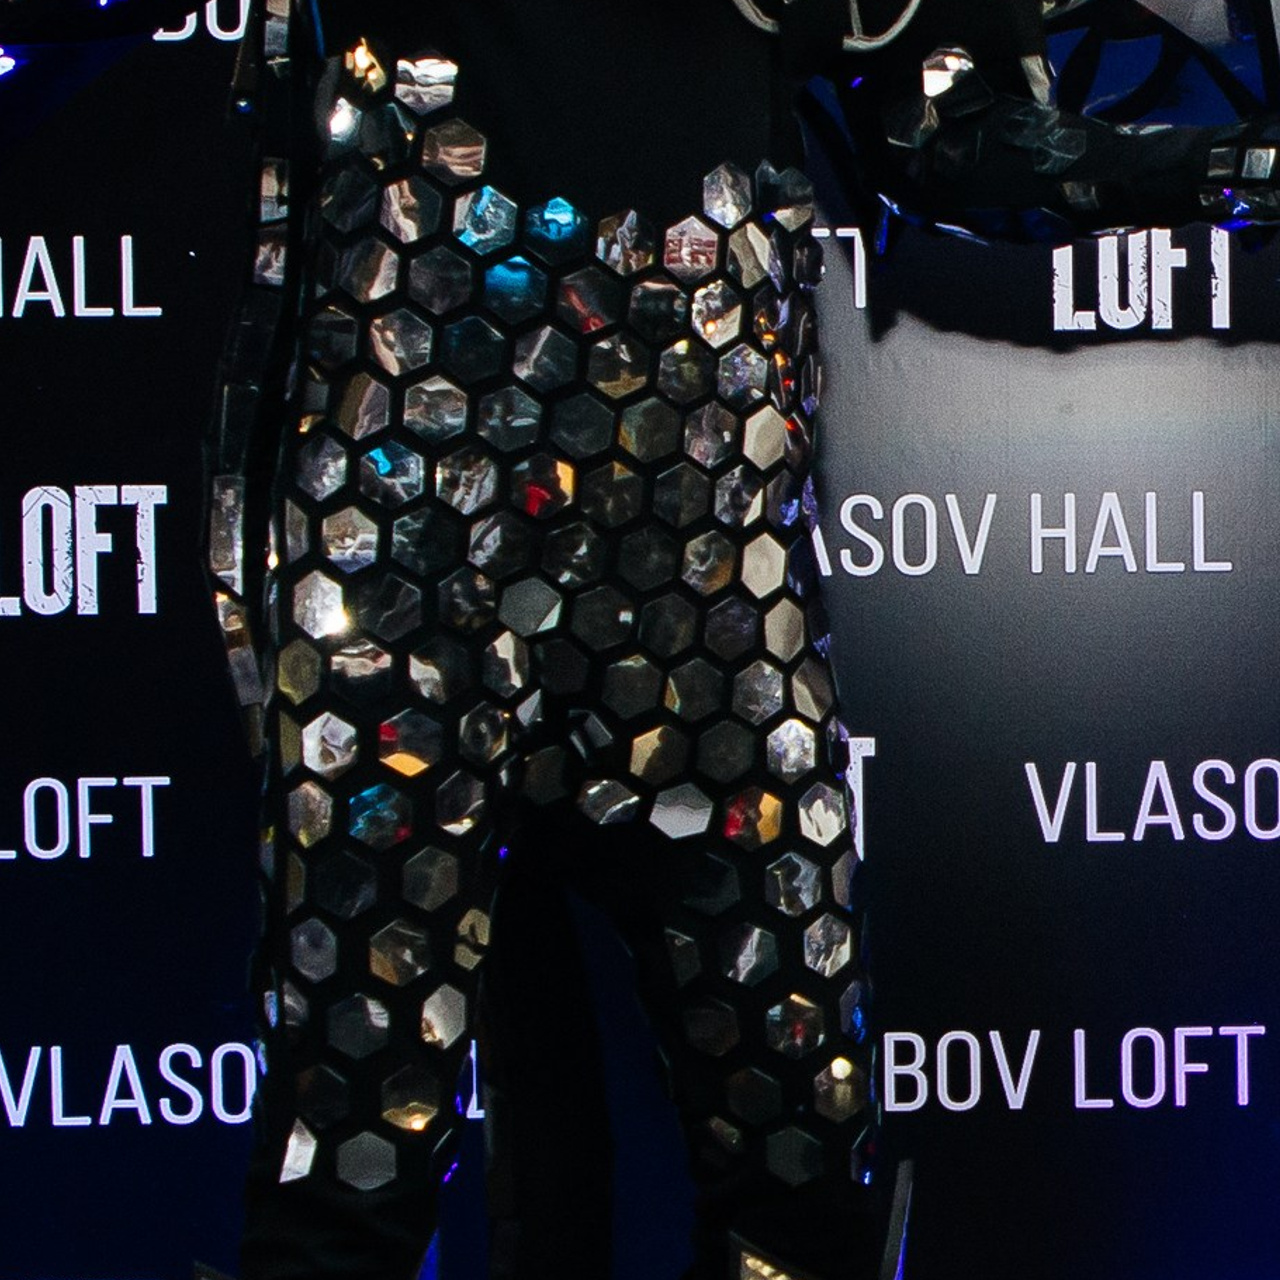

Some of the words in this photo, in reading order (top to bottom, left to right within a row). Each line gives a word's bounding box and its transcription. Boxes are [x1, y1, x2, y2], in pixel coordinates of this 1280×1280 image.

[0, 234, 163, 318] ALL
[0, 484, 168, 616] OFT
[1030, 491, 1233, 573] HALL
[0, 776, 171, 860] OFT
[883, 1029, 1041, 1112] BOV
[1073, 1025, 1266, 1109] LOFT
